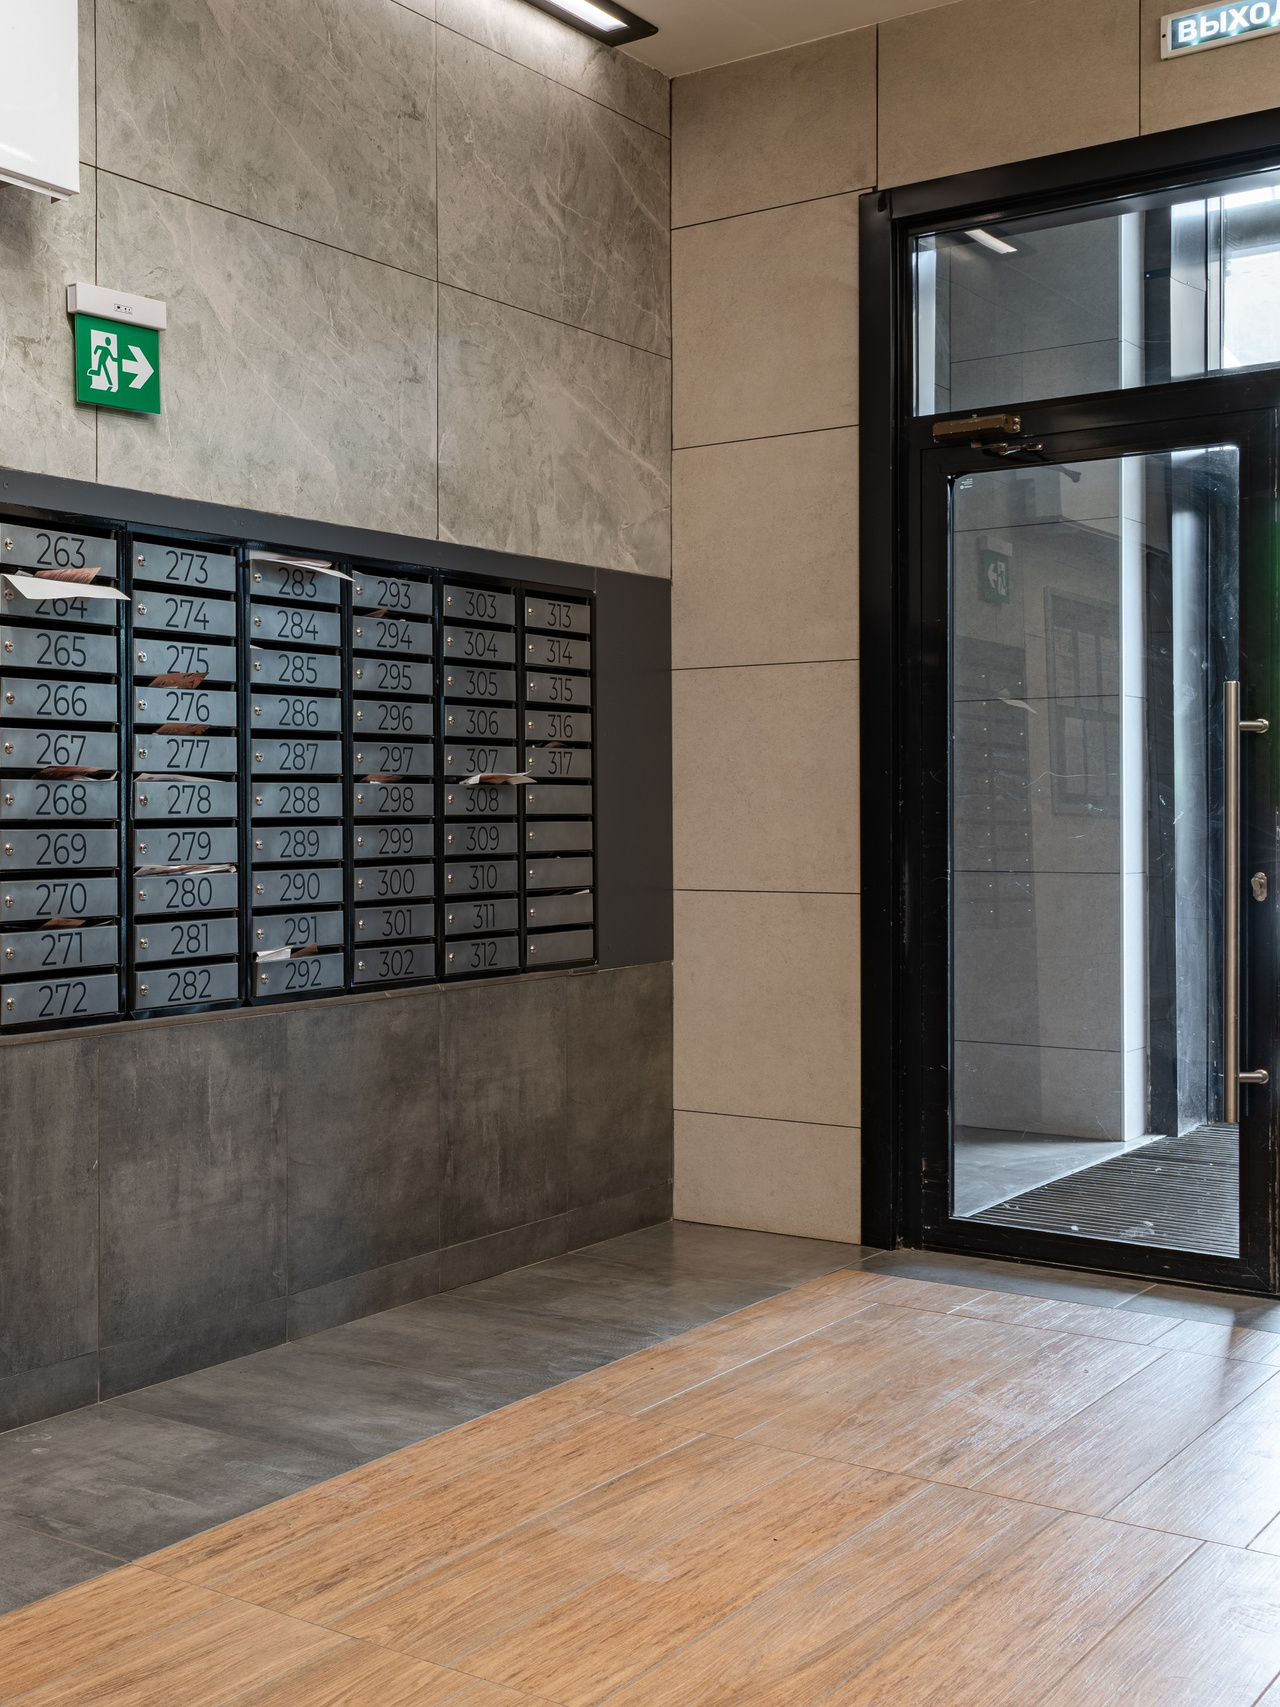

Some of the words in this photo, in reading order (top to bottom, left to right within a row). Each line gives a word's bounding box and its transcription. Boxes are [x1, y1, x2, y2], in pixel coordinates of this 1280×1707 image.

[36, 533, 85, 569] 263
[165, 550, 208, 584] 273
[278, 567, 317, 598] 283
[377, 580, 411, 609] 293
[165, 598, 209, 630] 274
[465, 591, 497, 619] 303
[547, 602, 571, 628] 313
[277, 610, 319, 641] 284
[376, 621, 413, 650] 294
[36, 633, 86, 667] 265
[464, 630, 498, 658] 304
[547, 639, 573, 665] 314
[166, 644, 209, 674] 275
[278, 654, 317, 684] 285
[378, 663, 412, 691] 295
[466, 670, 498, 696] 305
[549, 676, 573, 702] 315
[36, 683, 87, 717] 266
[166, 691, 210, 722] 276
[278, 698, 319, 727] 286
[378, 704, 413, 731] 296
[466, 709, 499, 735] 306
[548, 714, 573, 738] 316
[36, 733, 86, 766] 267
[166, 739, 210, 768] 277
[279, 742, 318, 770] 287
[379, 746, 414, 772] 297
[466, 748, 498, 773] 307
[548, 751, 573, 775] 317
[35, 783, 87, 815] 268
[167, 785, 211, 814] 278
[279, 786, 320, 814] 288
[378, 786, 414, 813] 298
[465, 787, 499, 812] 308
[36, 833, 87, 865] 269
[166, 831, 211, 862] 279
[279, 829, 320, 858] 289
[378, 827, 413, 855] 299
[466, 826, 499, 851] 309
[280, 872, 320, 902] 290
[377, 868, 415, 896] 300
[469, 864, 497, 890] 310
[36, 882, 87, 916] 270
[166, 877, 212, 909] 280
[382, 909, 412, 937] 301
[473, 903, 495, 929] 311
[171, 923, 208, 955] 281
[284, 916, 317, 946] 291
[41, 932, 83, 966] 271
[379, 949, 414, 977] 302
[470, 941, 498, 968] 312
[167, 969, 212, 1002] 282
[285, 959, 322, 990] 292
[38, 982, 87, 1018] 272
